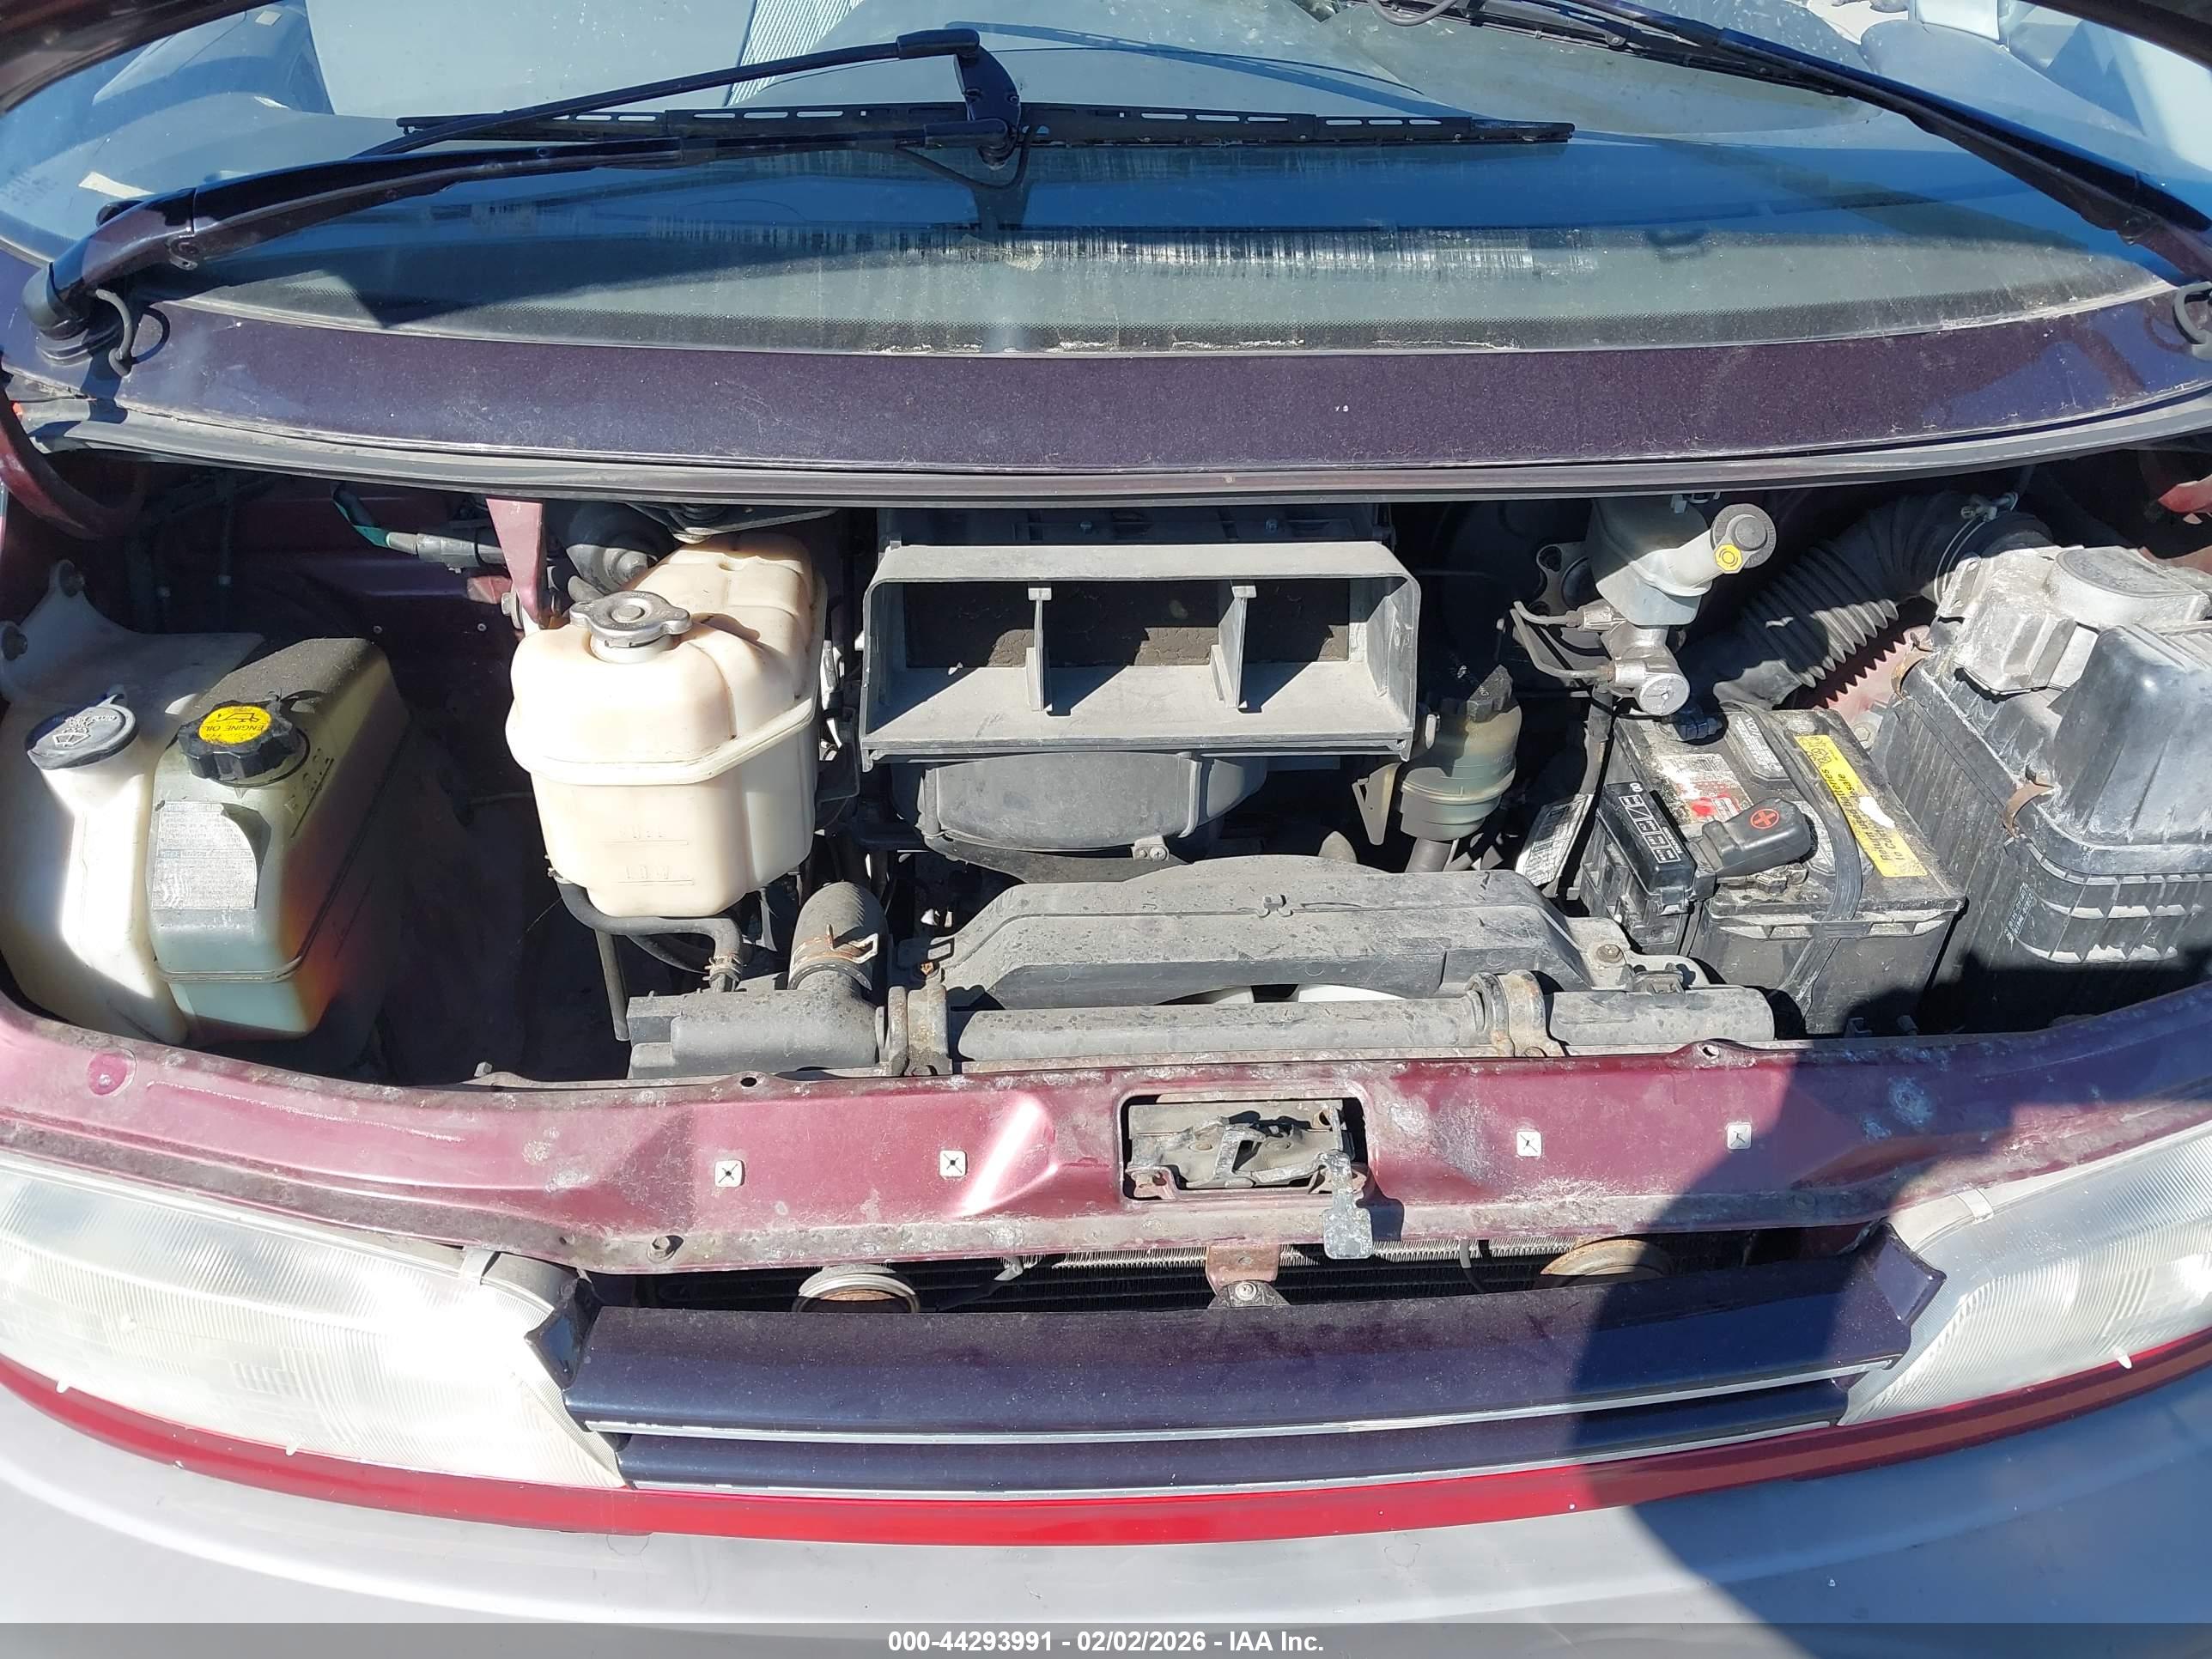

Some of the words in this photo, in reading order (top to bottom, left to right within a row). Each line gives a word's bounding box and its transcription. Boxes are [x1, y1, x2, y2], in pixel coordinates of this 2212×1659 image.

[1821, 769, 1852, 806] batteries
[1850, 809, 1869, 830] used
[1866, 831, 1891, 860] Return
